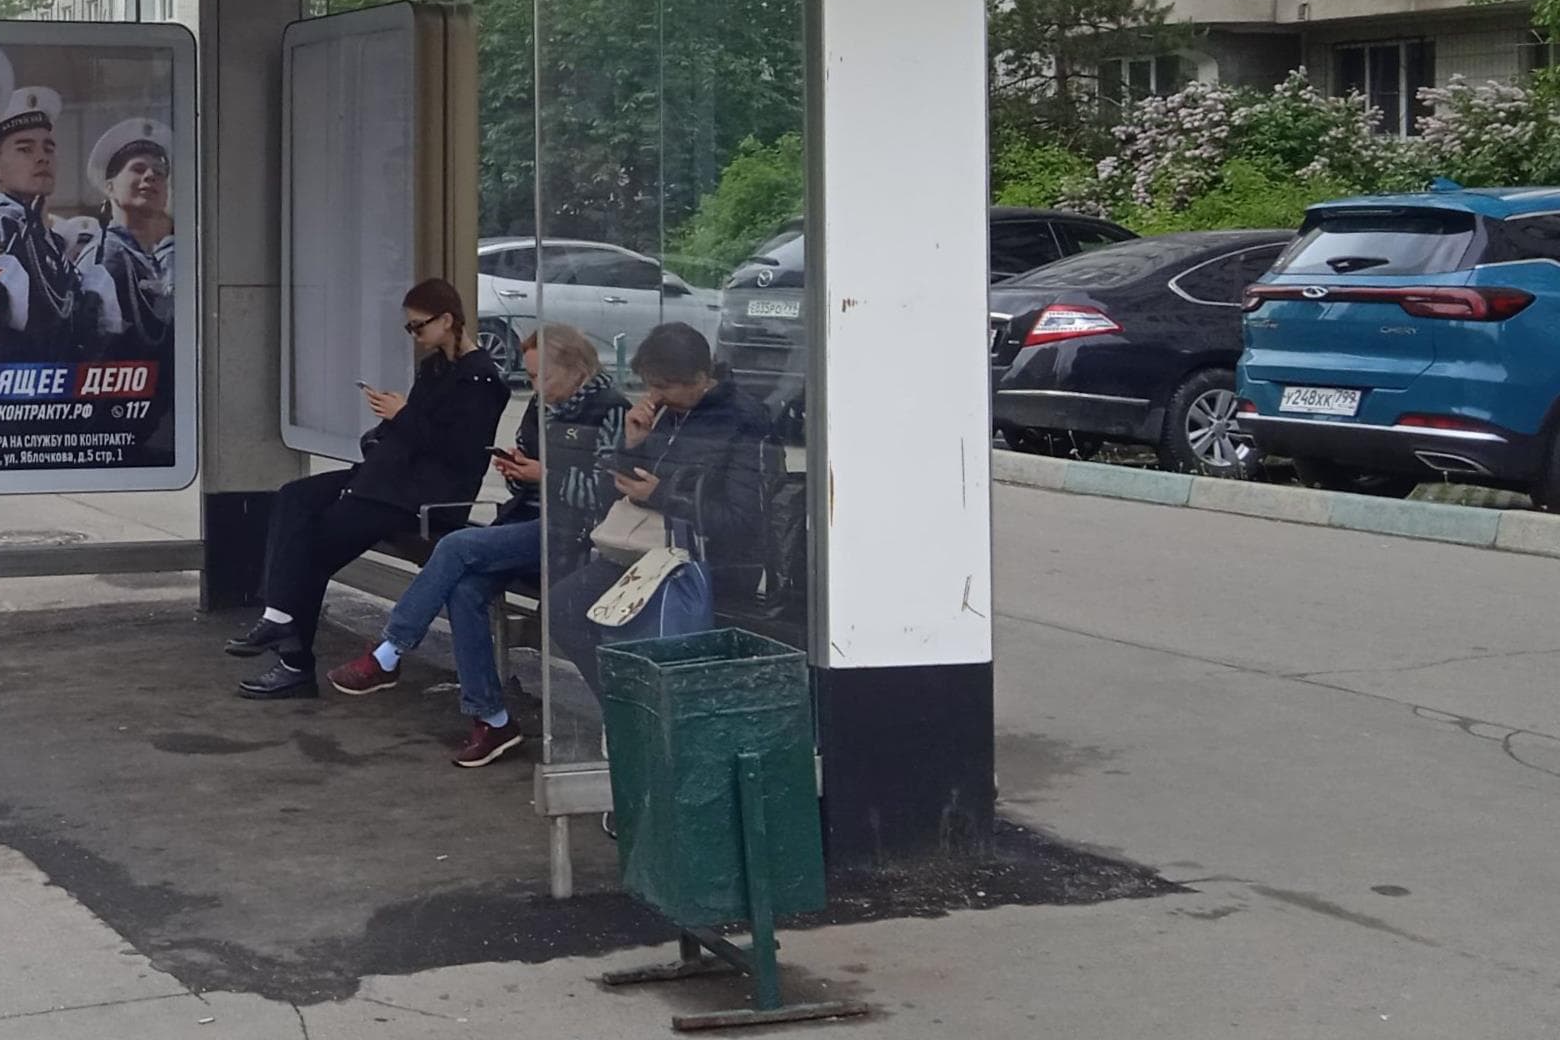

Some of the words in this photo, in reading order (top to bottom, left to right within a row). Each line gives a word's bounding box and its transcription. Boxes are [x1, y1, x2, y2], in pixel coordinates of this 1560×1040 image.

[80, 366, 148, 397] ДЕЛО
[125, 400, 151, 419] 117
[9, 434, 23, 448] НА
[24, 433, 63, 448] СЛУЖБУ
[64, 433, 78, 447] ПО
[79, 432, 136, 446] КОНТРАКТУ:
[3, 453, 19, 467] ул.
[20, 450, 77, 465] Яблочкова,
[78, 448, 94, 464] д.5
[95, 450, 116, 464] стр.
[117, 448, 124, 461] 1
